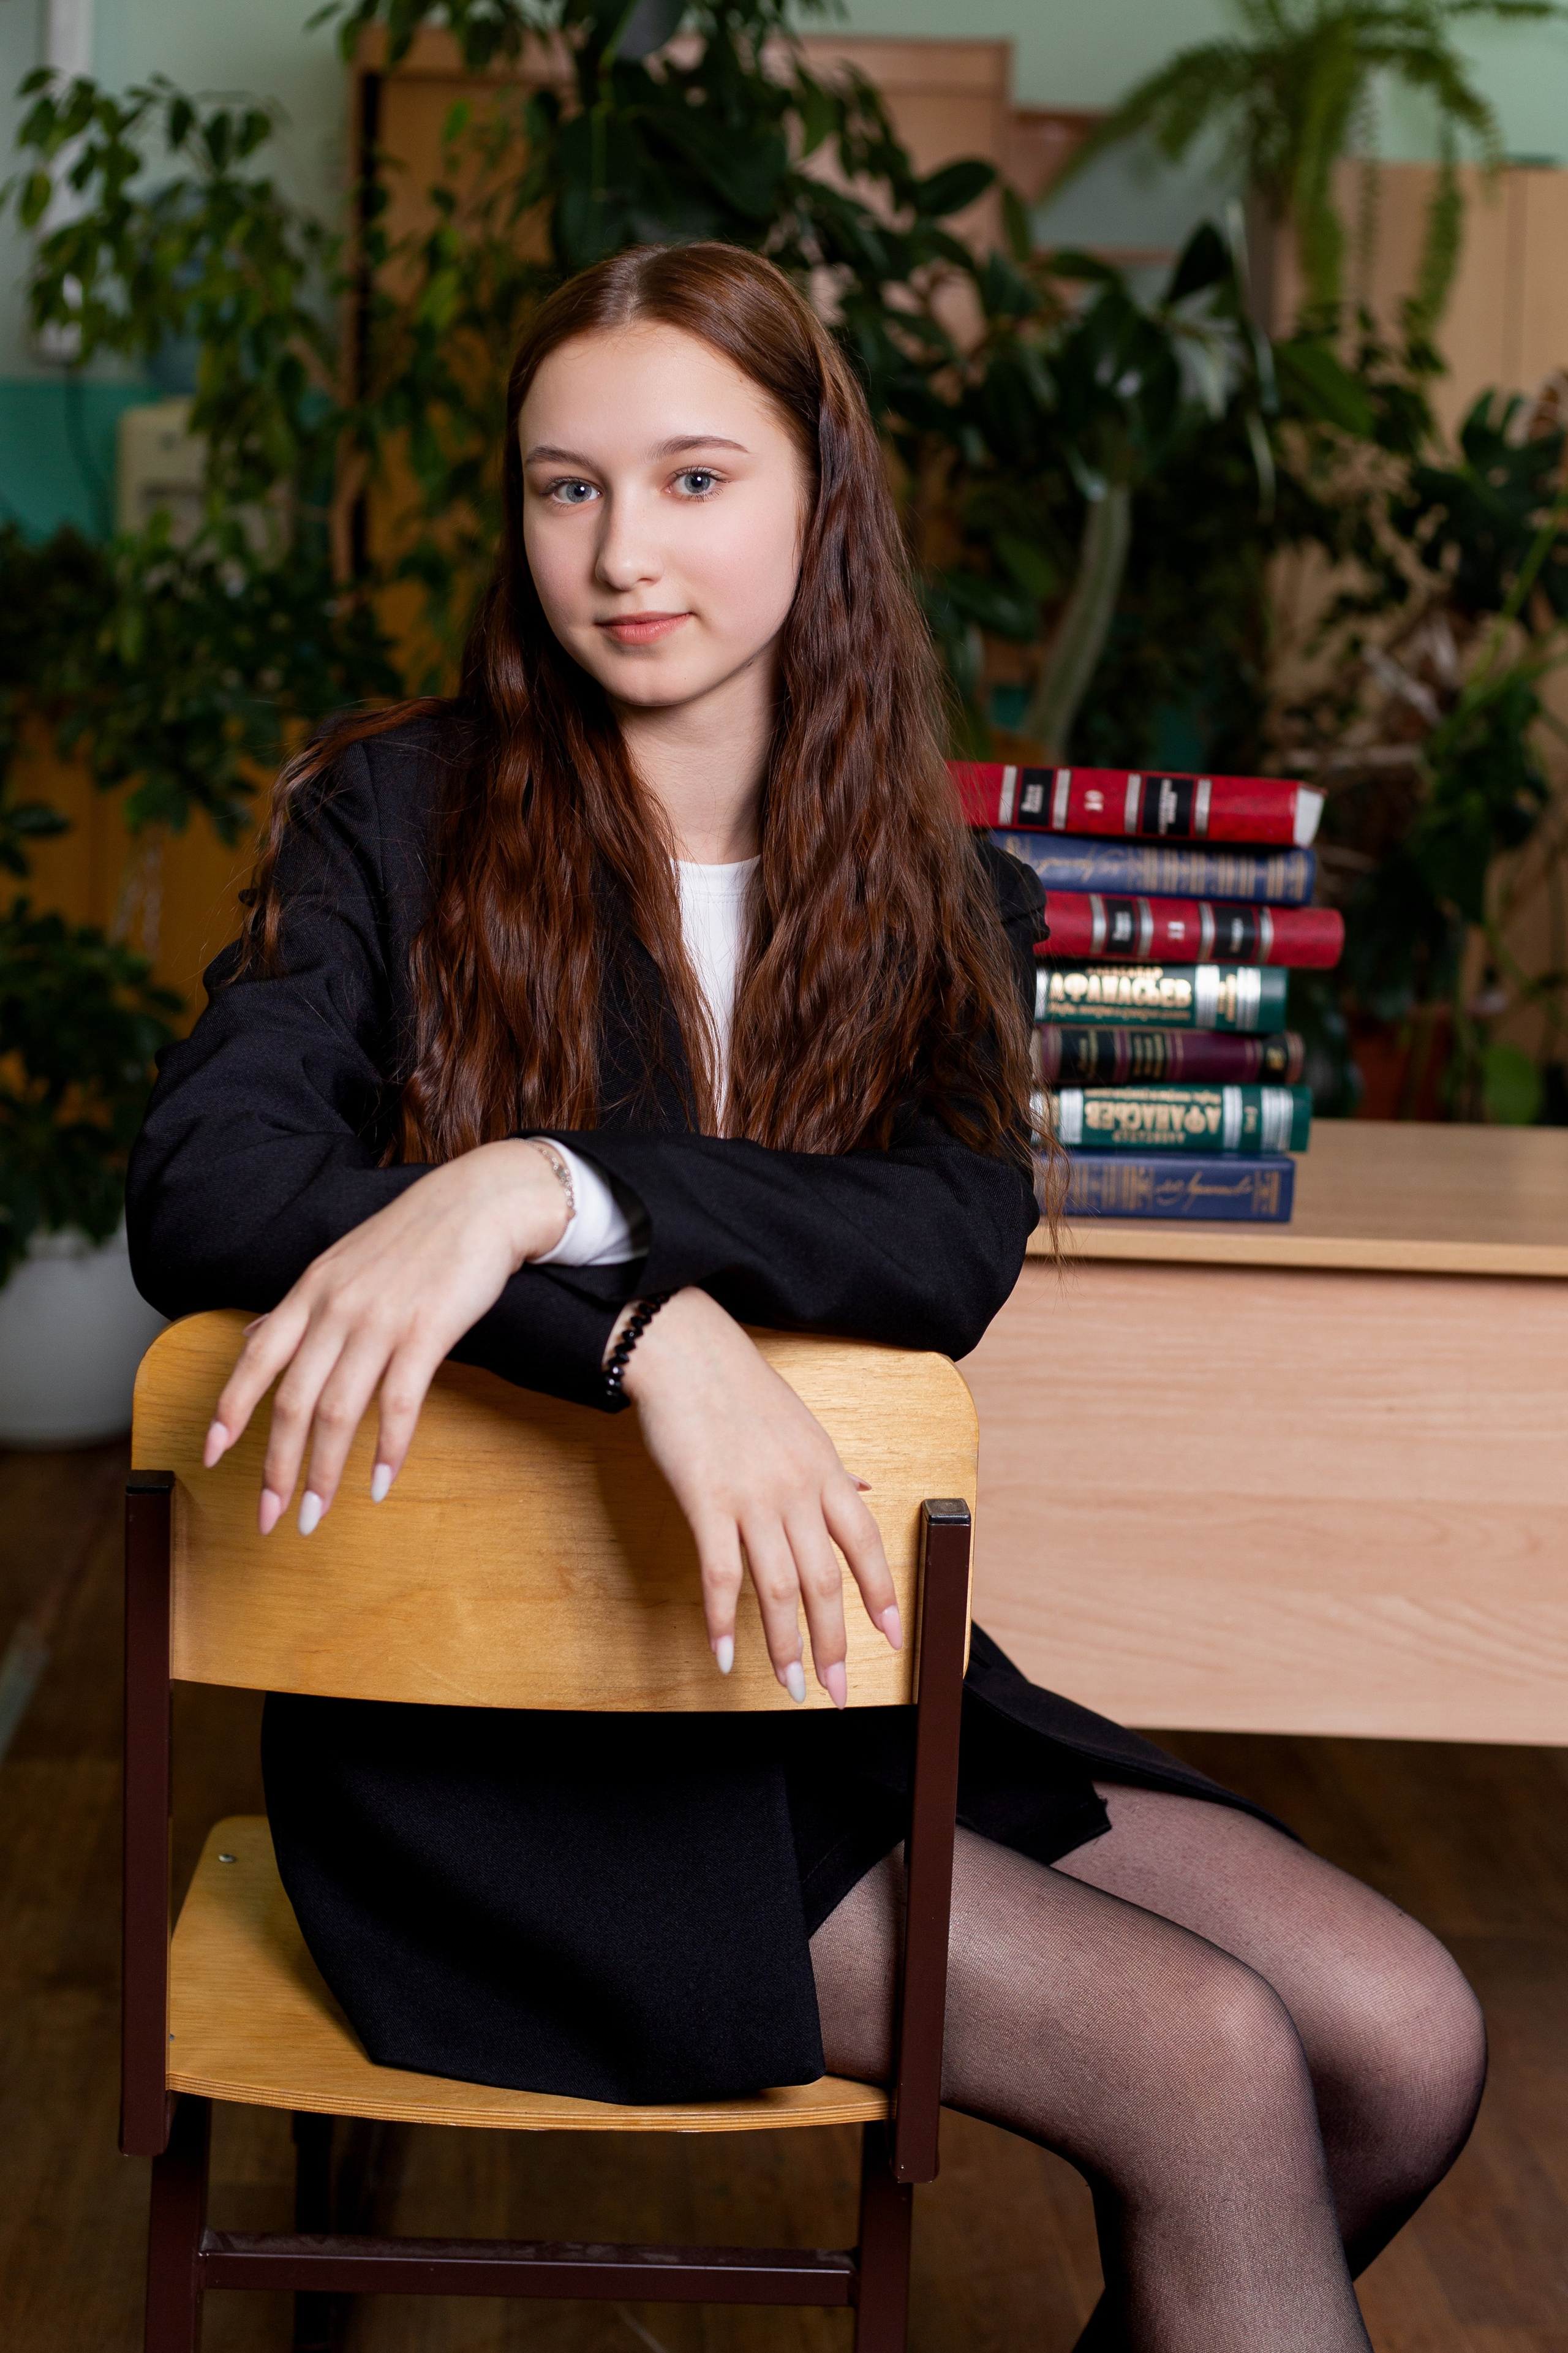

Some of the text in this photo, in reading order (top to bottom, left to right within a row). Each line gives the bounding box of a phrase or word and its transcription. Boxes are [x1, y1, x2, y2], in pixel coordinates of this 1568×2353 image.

[1083, 789, 1104, 813] 10
[1049, 972, 1192, 1008] АФАНАСЬЕВ
[1084, 1101, 1222, 1134] АФАНАСЬЕВ
